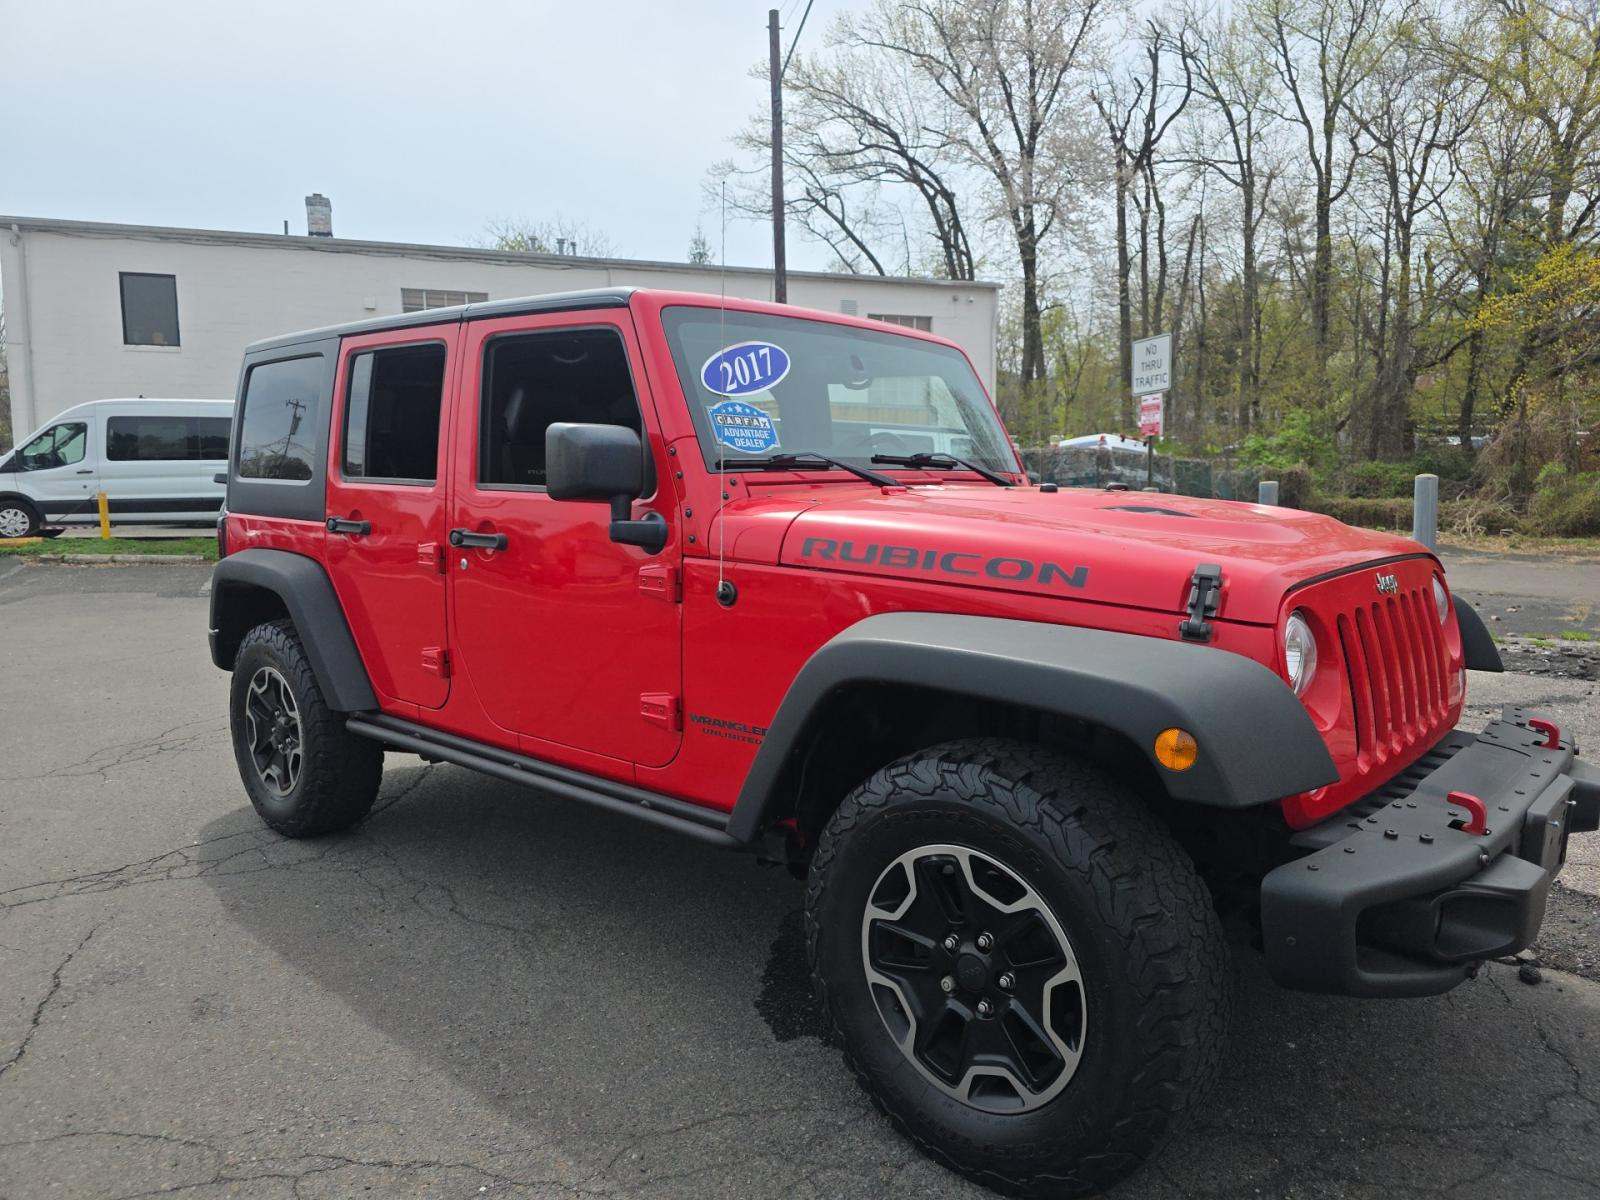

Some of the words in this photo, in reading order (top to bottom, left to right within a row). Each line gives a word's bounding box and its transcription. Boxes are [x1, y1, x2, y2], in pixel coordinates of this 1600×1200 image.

[1145, 343, 1158, 356] NO
[719, 347, 772, 392] 2017
[1140, 359, 1163, 372] THRU
[1135, 373, 1168, 389] TRAFFIC
[716, 414, 770, 429] CARFAX
[724, 427, 770, 439] ADVANTAGE
[735, 437, 766, 449] DEALER
[801, 536, 1089, 588] RUBICON
[1376, 572, 1398, 595] Jeep
[703, 729, 762, 744] UNLIMITED
